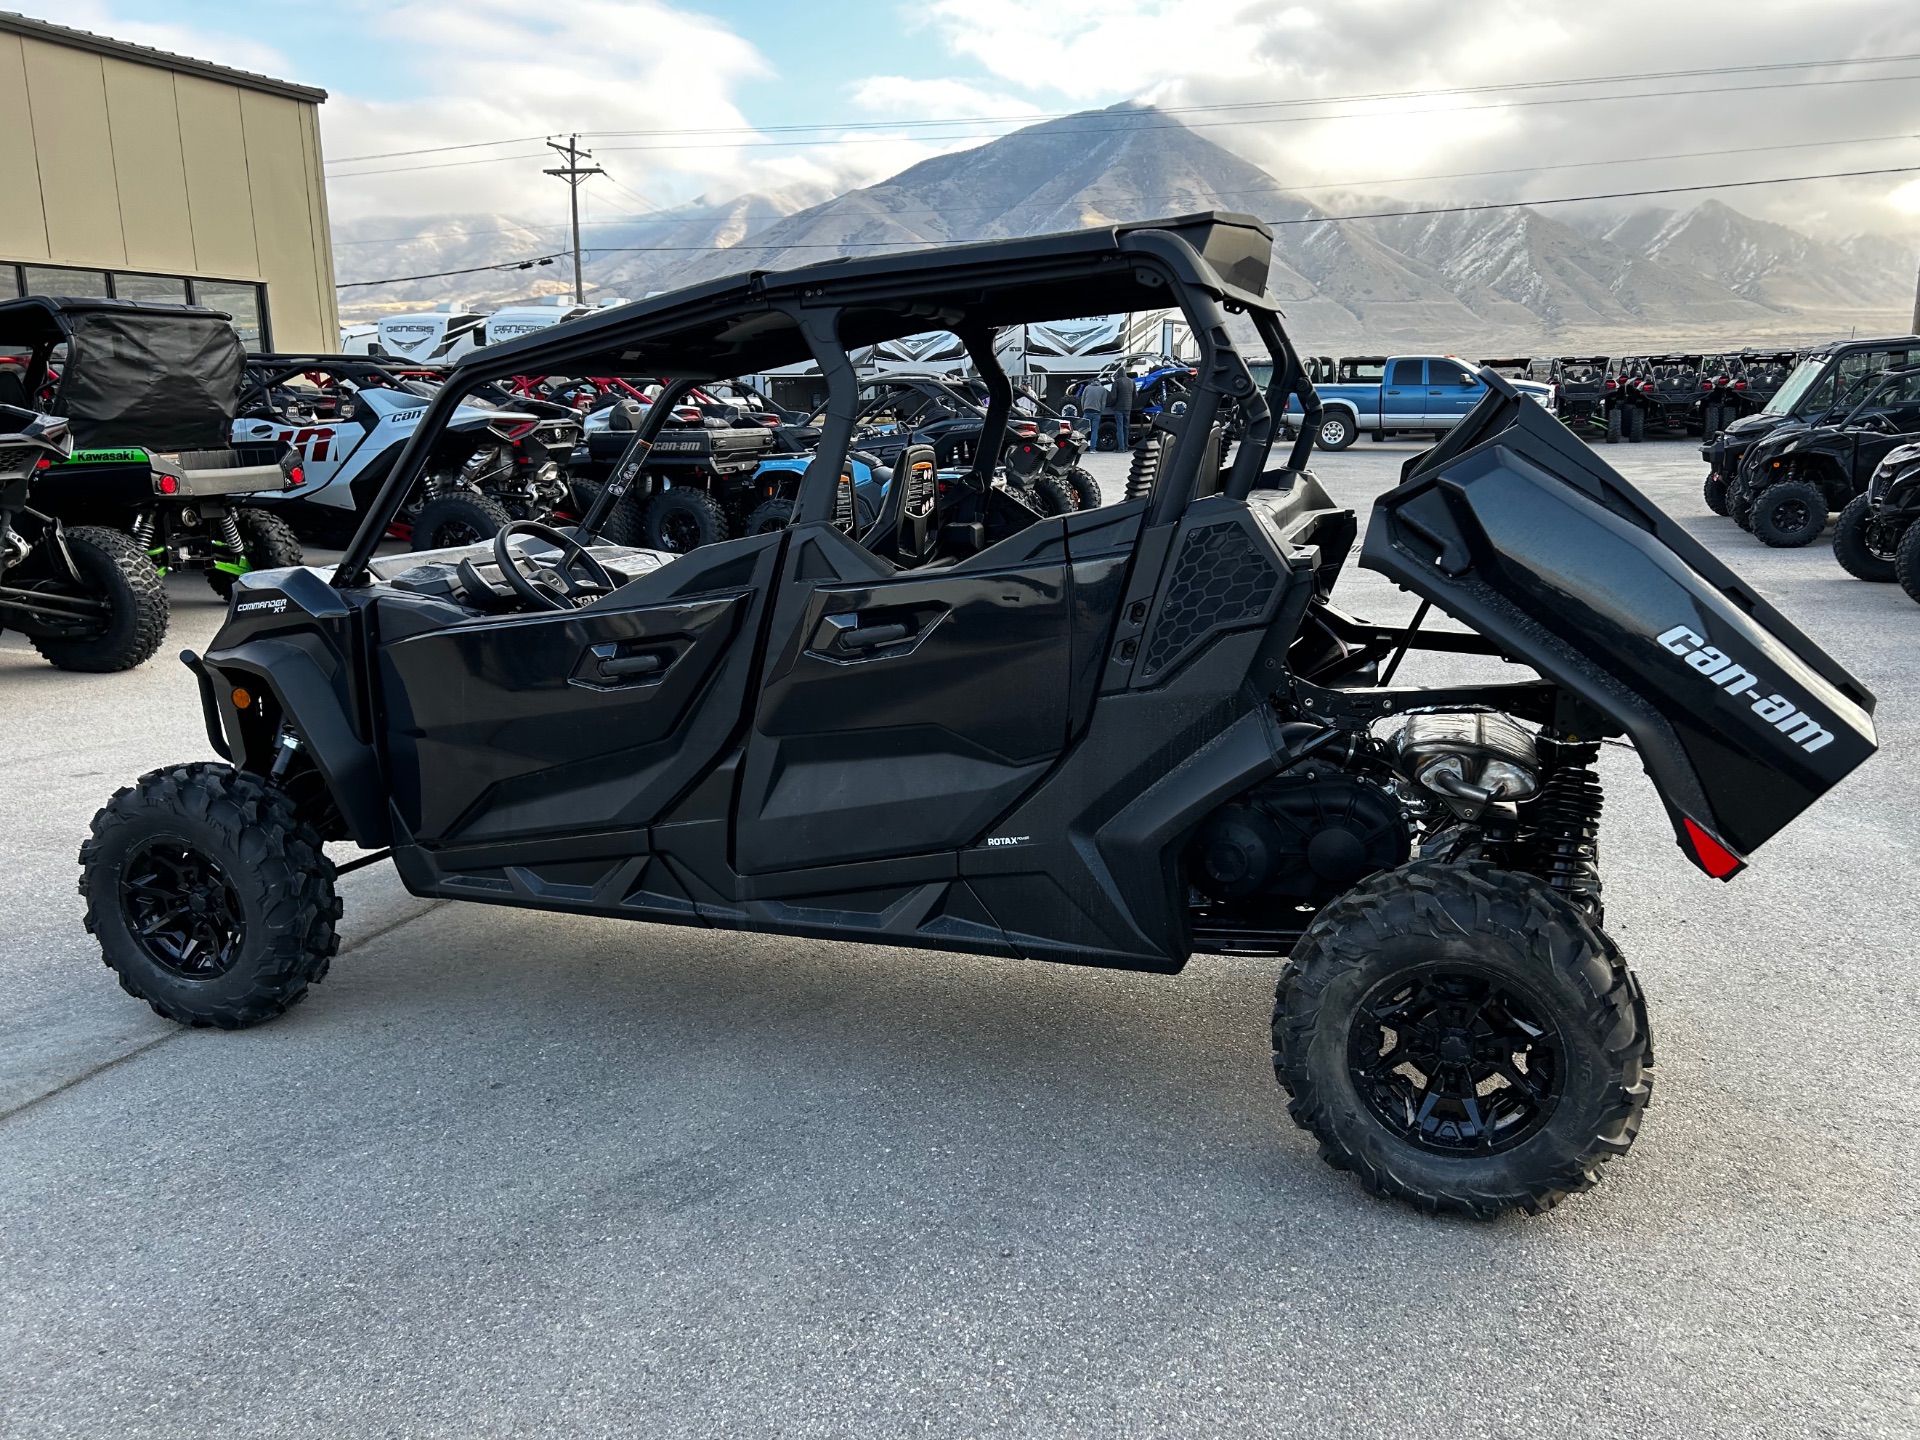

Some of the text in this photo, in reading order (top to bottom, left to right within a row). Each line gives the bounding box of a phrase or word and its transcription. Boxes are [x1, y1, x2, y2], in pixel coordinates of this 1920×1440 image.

[386, 325, 435, 333] GENESIS
[391, 410, 425, 423] can-
[652, 441, 701, 451] can-am
[77, 450, 135, 462] Kawasaki
[237, 598, 287, 612] COMMANDER
[1656, 625, 1835, 753] can-am
[987, 836, 1018, 846] ROTAX
